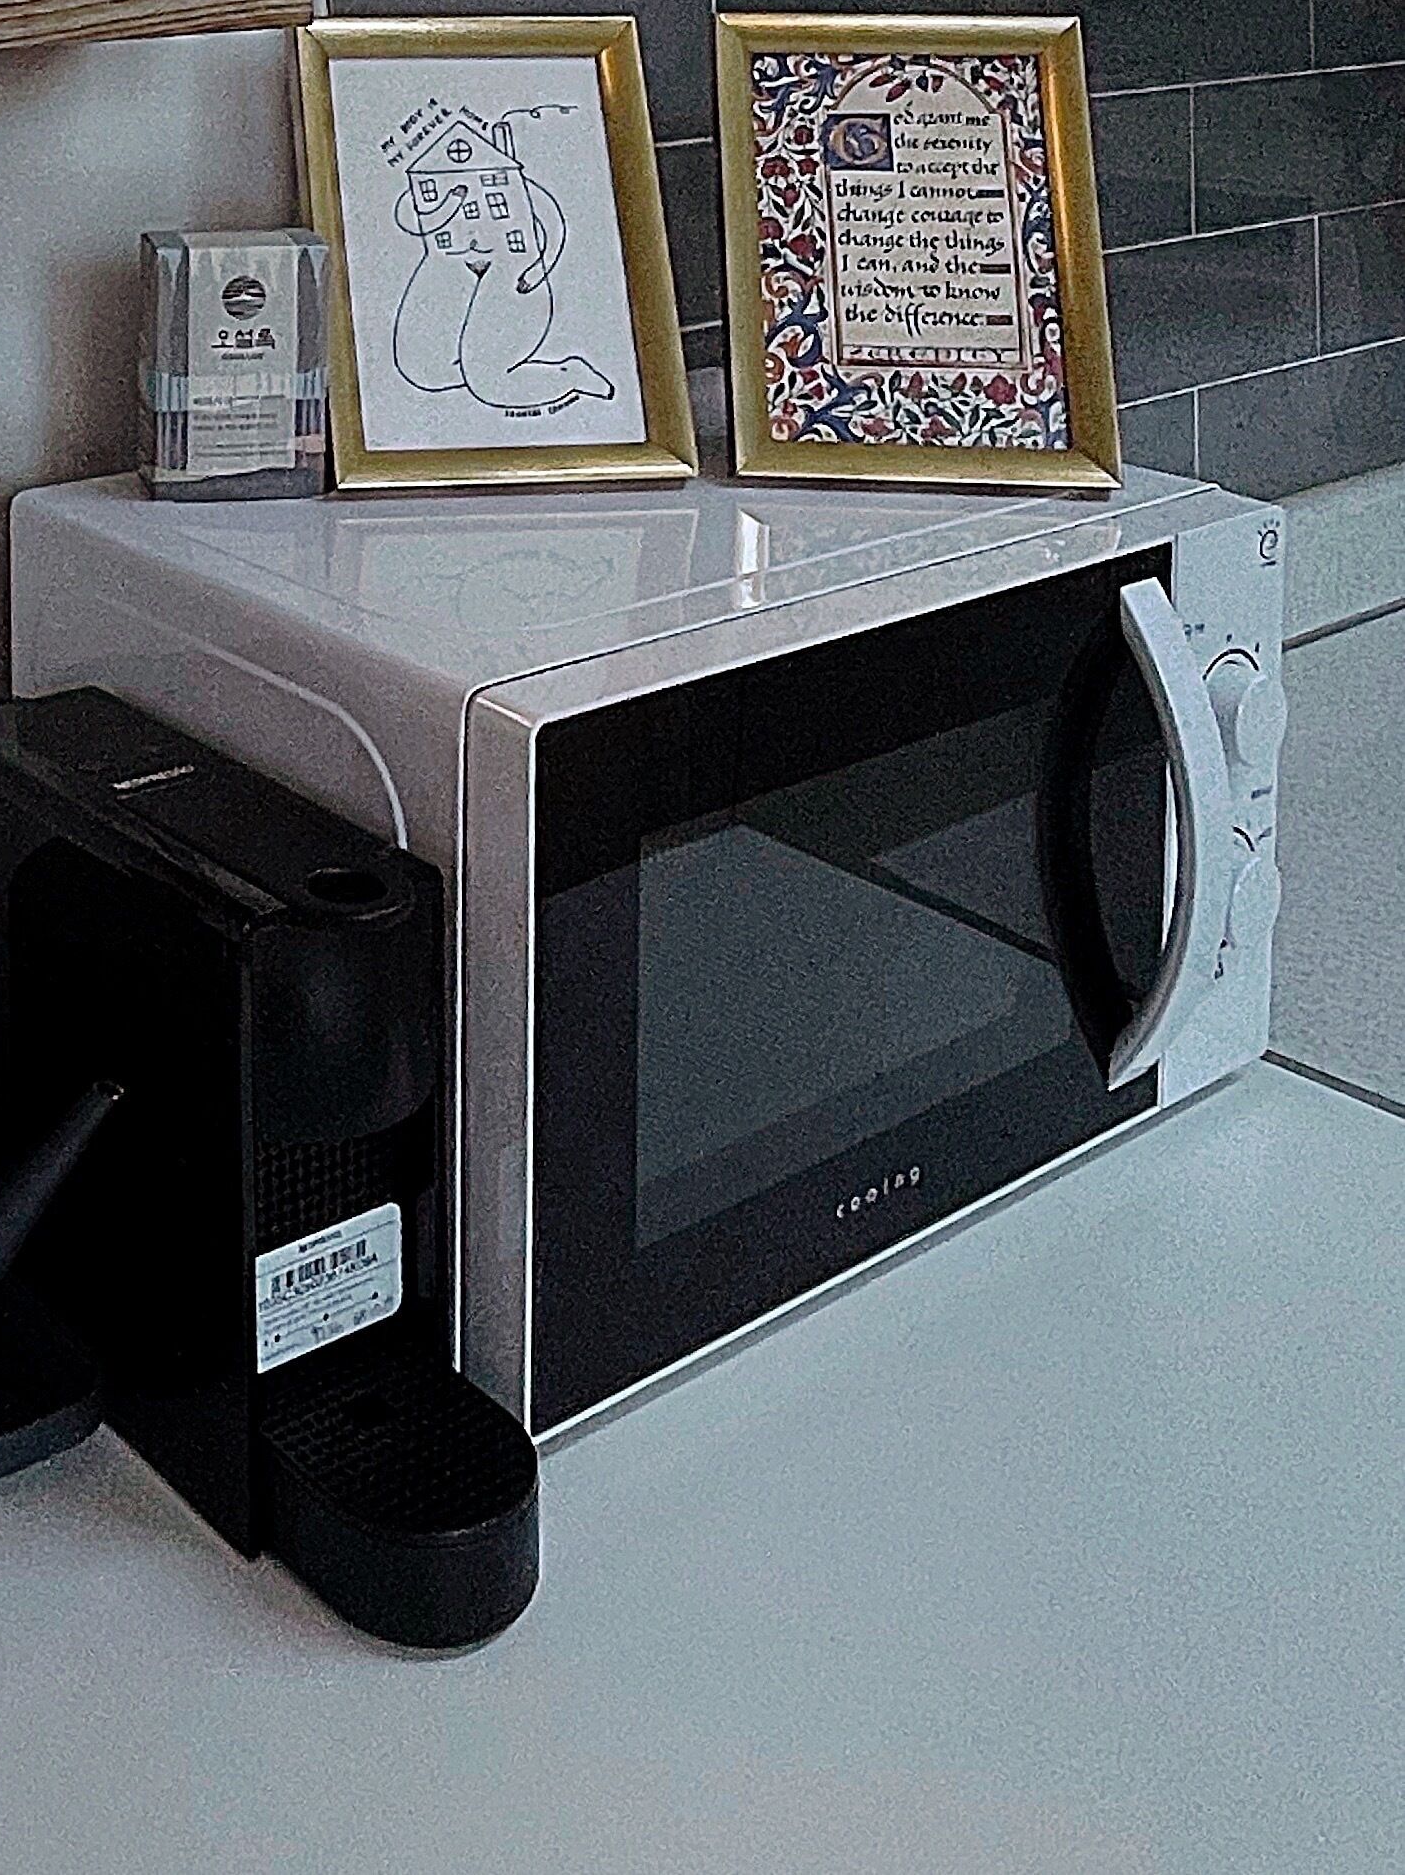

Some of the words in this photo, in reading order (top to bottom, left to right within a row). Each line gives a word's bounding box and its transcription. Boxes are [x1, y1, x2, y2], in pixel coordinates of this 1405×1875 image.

[916, 112, 963, 128] grant
[965, 114, 991, 127] me
[387, 150, 405, 168] MY
[406, 107, 453, 151] FOREVER
[894, 132, 919, 149] the
[923, 134, 993, 155] serenity
[897, 161, 913, 174] to
[916, 160, 969, 180] accept
[971, 157, 1001, 176] the
[835, 179, 893, 203] things
[898, 180, 905, 199] I
[909, 184, 979, 199] cannot
[837, 202, 905, 229] change
[910, 209, 983, 228] courage
[986, 210, 1005, 224] to
[837, 229, 905, 253] change
[909, 230, 940, 250] the
[944, 229, 1005, 257] things
[842, 254, 848, 272] I
[901, 251, 940, 274] and
[944, 255, 981, 275] the
[841, 276, 915, 299] wisdom
[918, 283, 941, 298] to
[944, 280, 1001, 300] know
[845, 303, 878, 323] the
